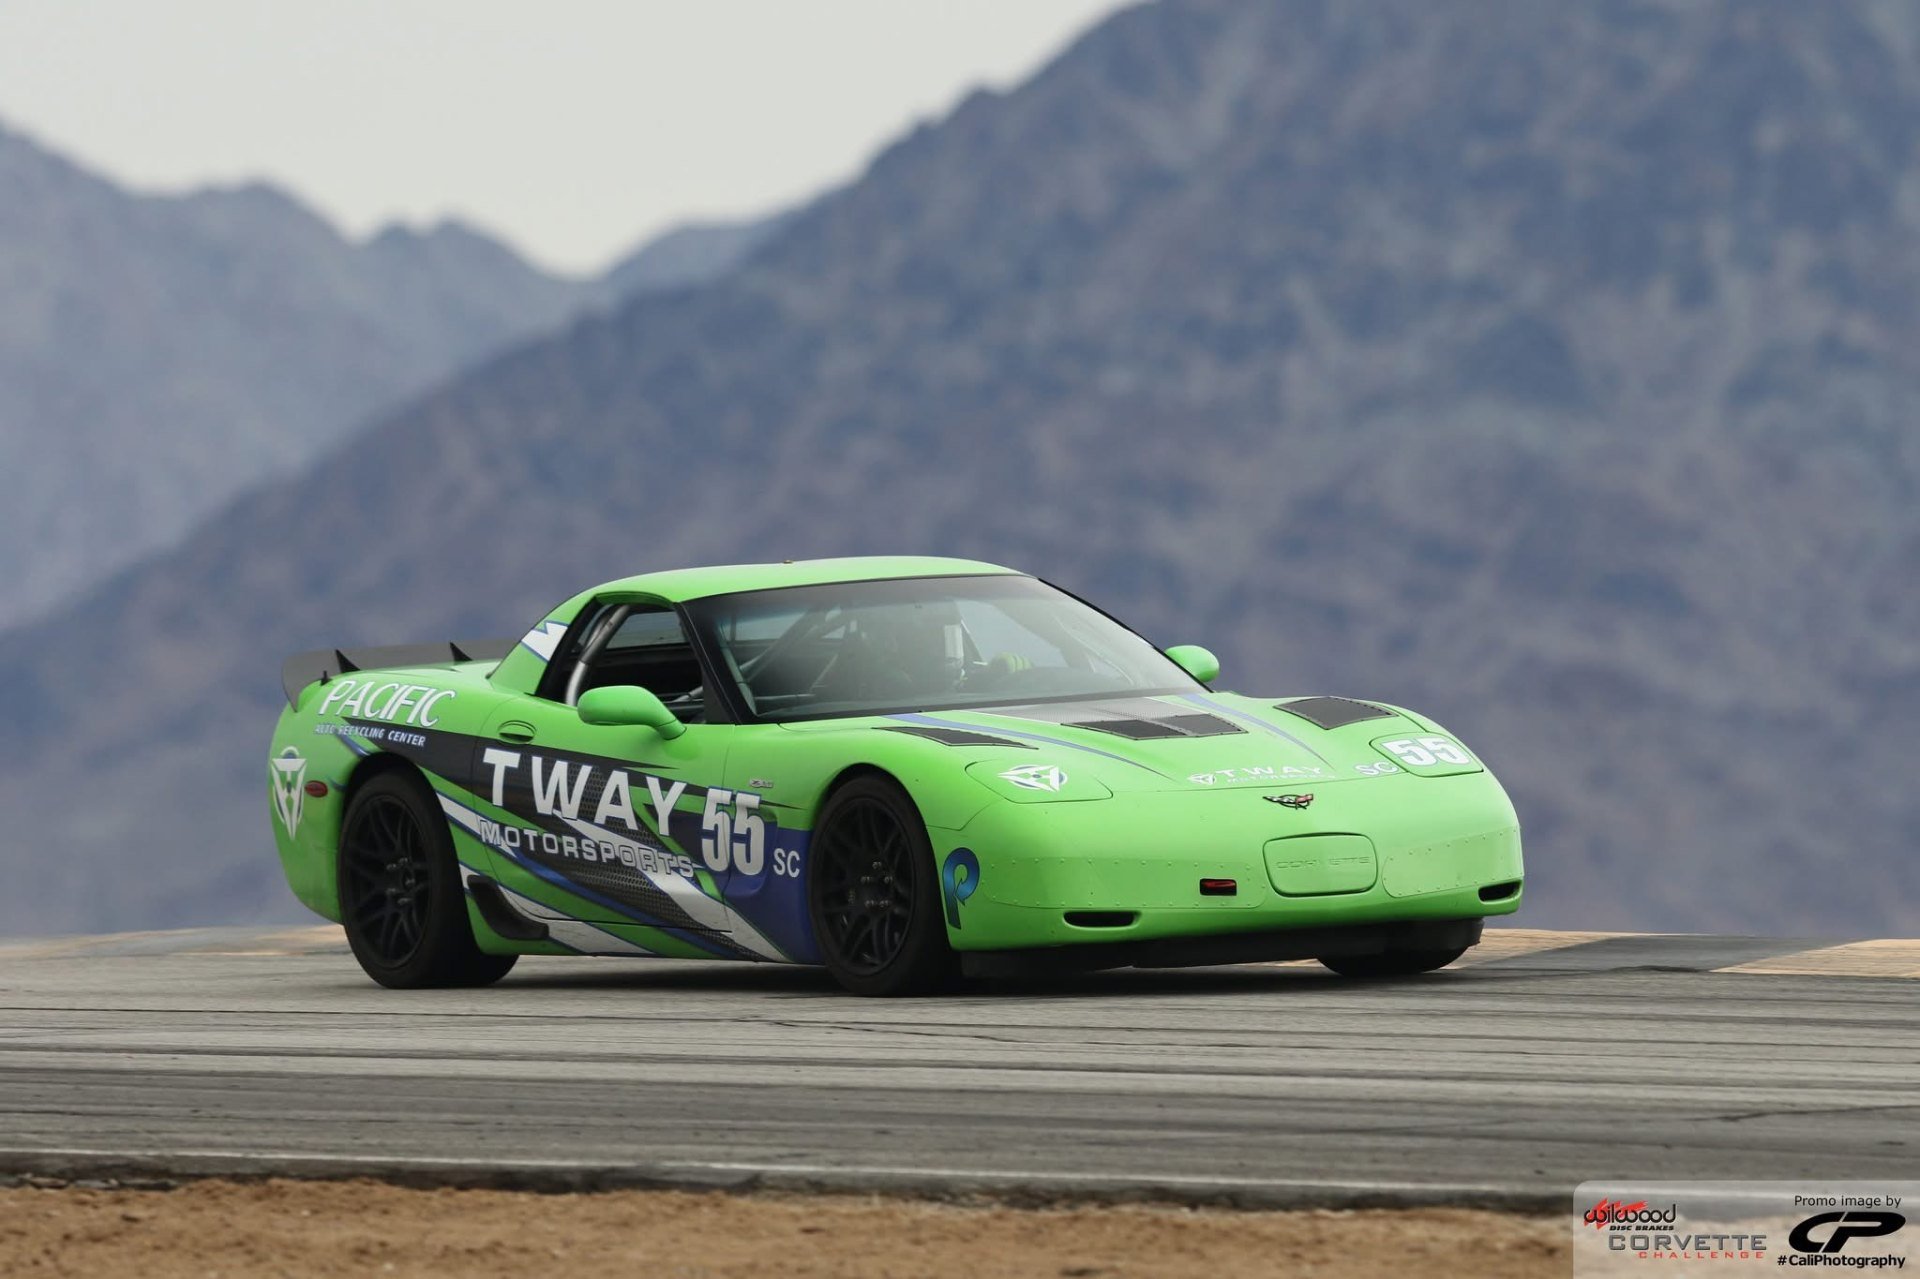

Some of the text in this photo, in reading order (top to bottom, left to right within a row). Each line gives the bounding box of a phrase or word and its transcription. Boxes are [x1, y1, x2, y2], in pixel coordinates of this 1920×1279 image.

[317, 680, 456, 727] PACIFIC
[388, 730, 427, 747] CENTER
[1380, 736, 1471, 766] 55
[1353, 761, 1399, 776] SC
[482, 748, 688, 836] TWAY
[479, 817, 695, 878] MOTORSPORTS
[701, 786, 766, 876] 55
[773, 848, 801, 878] SC
